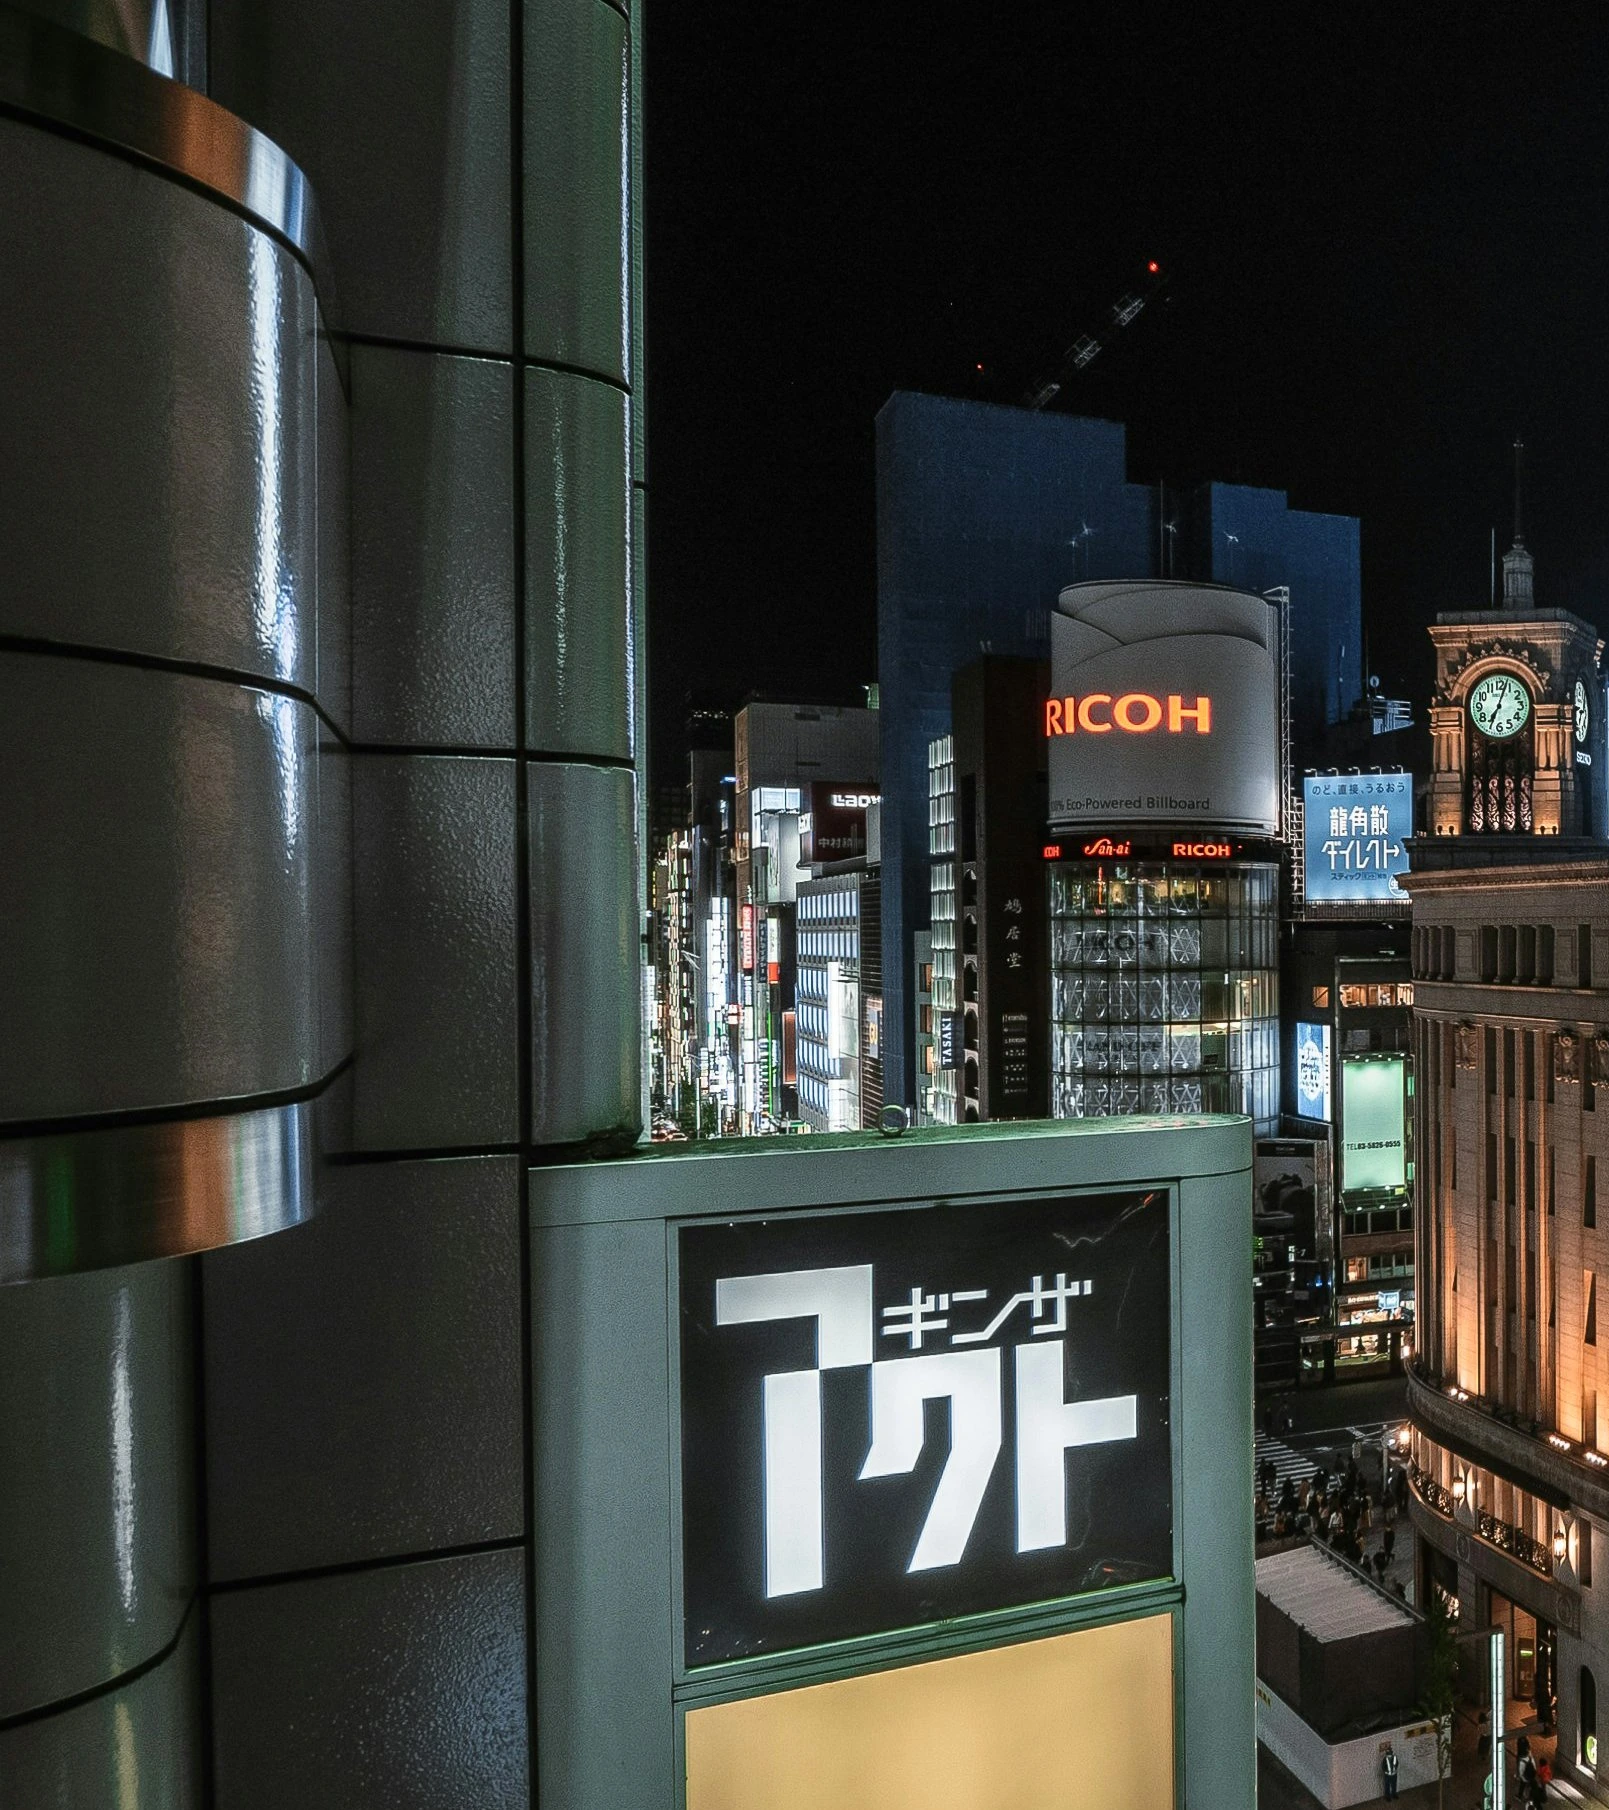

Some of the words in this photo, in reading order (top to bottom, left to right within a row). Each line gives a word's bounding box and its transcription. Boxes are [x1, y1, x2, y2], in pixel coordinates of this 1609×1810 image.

[1486, 682, 1493, 693] 11
[1495, 680, 1505, 690] 12
[1479, 691, 1487, 701] 10
[1514, 690, 1521, 700] 2
[1475, 702, 1483, 712] 9
[1517, 701, 1524, 711] 3
[1045, 693, 1212, 736] RICOH
[1479, 712, 1486, 722] 8
[1513, 711, 1521, 721] 4
[1496, 722, 1503, 732] 6
[1506, 719, 1513, 729] 5
[1146, 796, 1210, 810] Billboard
[1329, 804, 1389, 837] 龍角散
[1084, 838, 1130, 856] San-ai
[1173, 843, 1231, 856] RICOH
[1321, 840, 1400, 870] ダイレクト
[942, 1017, 952, 1065] TASAKI
[882, 1273, 1093, 1349] ギンザ
